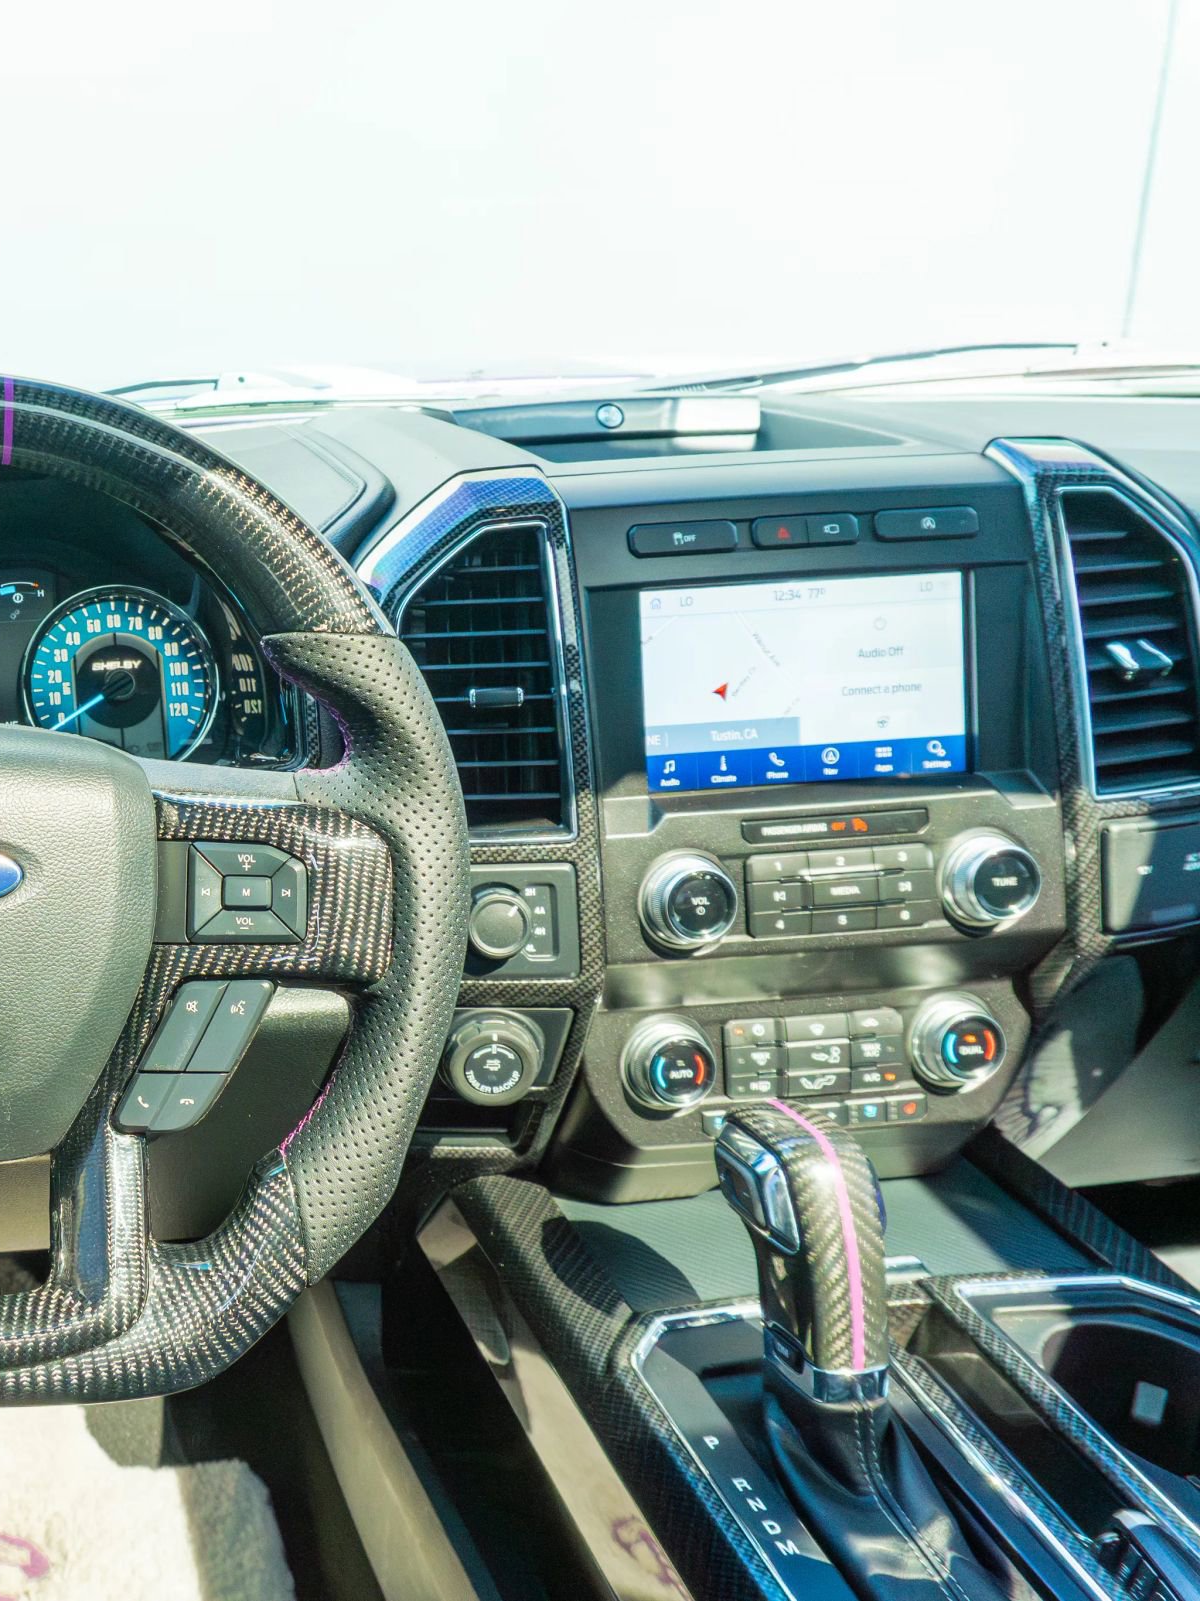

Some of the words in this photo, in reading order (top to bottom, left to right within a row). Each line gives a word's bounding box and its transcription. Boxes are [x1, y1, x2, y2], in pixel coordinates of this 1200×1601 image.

[683, 534, 696, 543] OFF
[37, 589, 45, 597] H
[919, 582, 933, 593] LO
[680, 596, 693, 607] LO
[773, 590, 801, 601] 12:34
[86, 619, 101, 633] 50
[106, 614, 121, 628] 60
[128, 616, 143, 631] 70
[65, 631, 80, 645] 40
[148, 626, 163, 640] 80
[164, 642, 179, 656] 90
[857, 647, 886, 658] Audio
[888, 645, 904, 657] Off
[54, 649, 68, 662] 30
[91, 660, 142, 671] SHELBY
[169, 662, 189, 676] 100
[47, 670, 62, 684] 20
[171, 681, 189, 696] 110
[841, 684, 881, 696] Connect
[883, 686, 890, 694] a
[891, 682, 922, 695] phone
[48, 692, 62, 705] 10
[169, 702, 189, 717] 120
[647, 734, 661, 746] NE
[709, 730, 744, 742] Tustin,
[744, 728, 758, 740] CA
[710, 775, 737, 784] Climate
[766, 771, 789, 779] Phone
[660, 778, 681, 787] Audio
[237, 854, 256, 864] VOL
[836, 856, 845, 866] 2
[898, 851, 908, 862] 3
[774, 861, 782, 871] 1
[991, 876, 1018, 887] TUNE
[242, 888, 251, 897] M
[830, 885, 861, 896] MEDIA
[691, 896, 710, 906] VOL
[235, 917, 254, 926] VOL
[837, 915, 848, 926] 5
[900, 910, 910, 921] 6
[775, 919, 785, 930] 4
[958, 1044, 984, 1056] DUAL
[669, 1069, 694, 1079] AUTO
[465, 1070, 491, 1093] TRAILER
[492, 1070, 520, 1094] BACKUP
[702, 1434, 720, 1450] P
[731, 1476, 752, 1492] R
[746, 1497, 767, 1513] N
[761, 1518, 781, 1535] D
[774, 1539, 800, 1557] M
